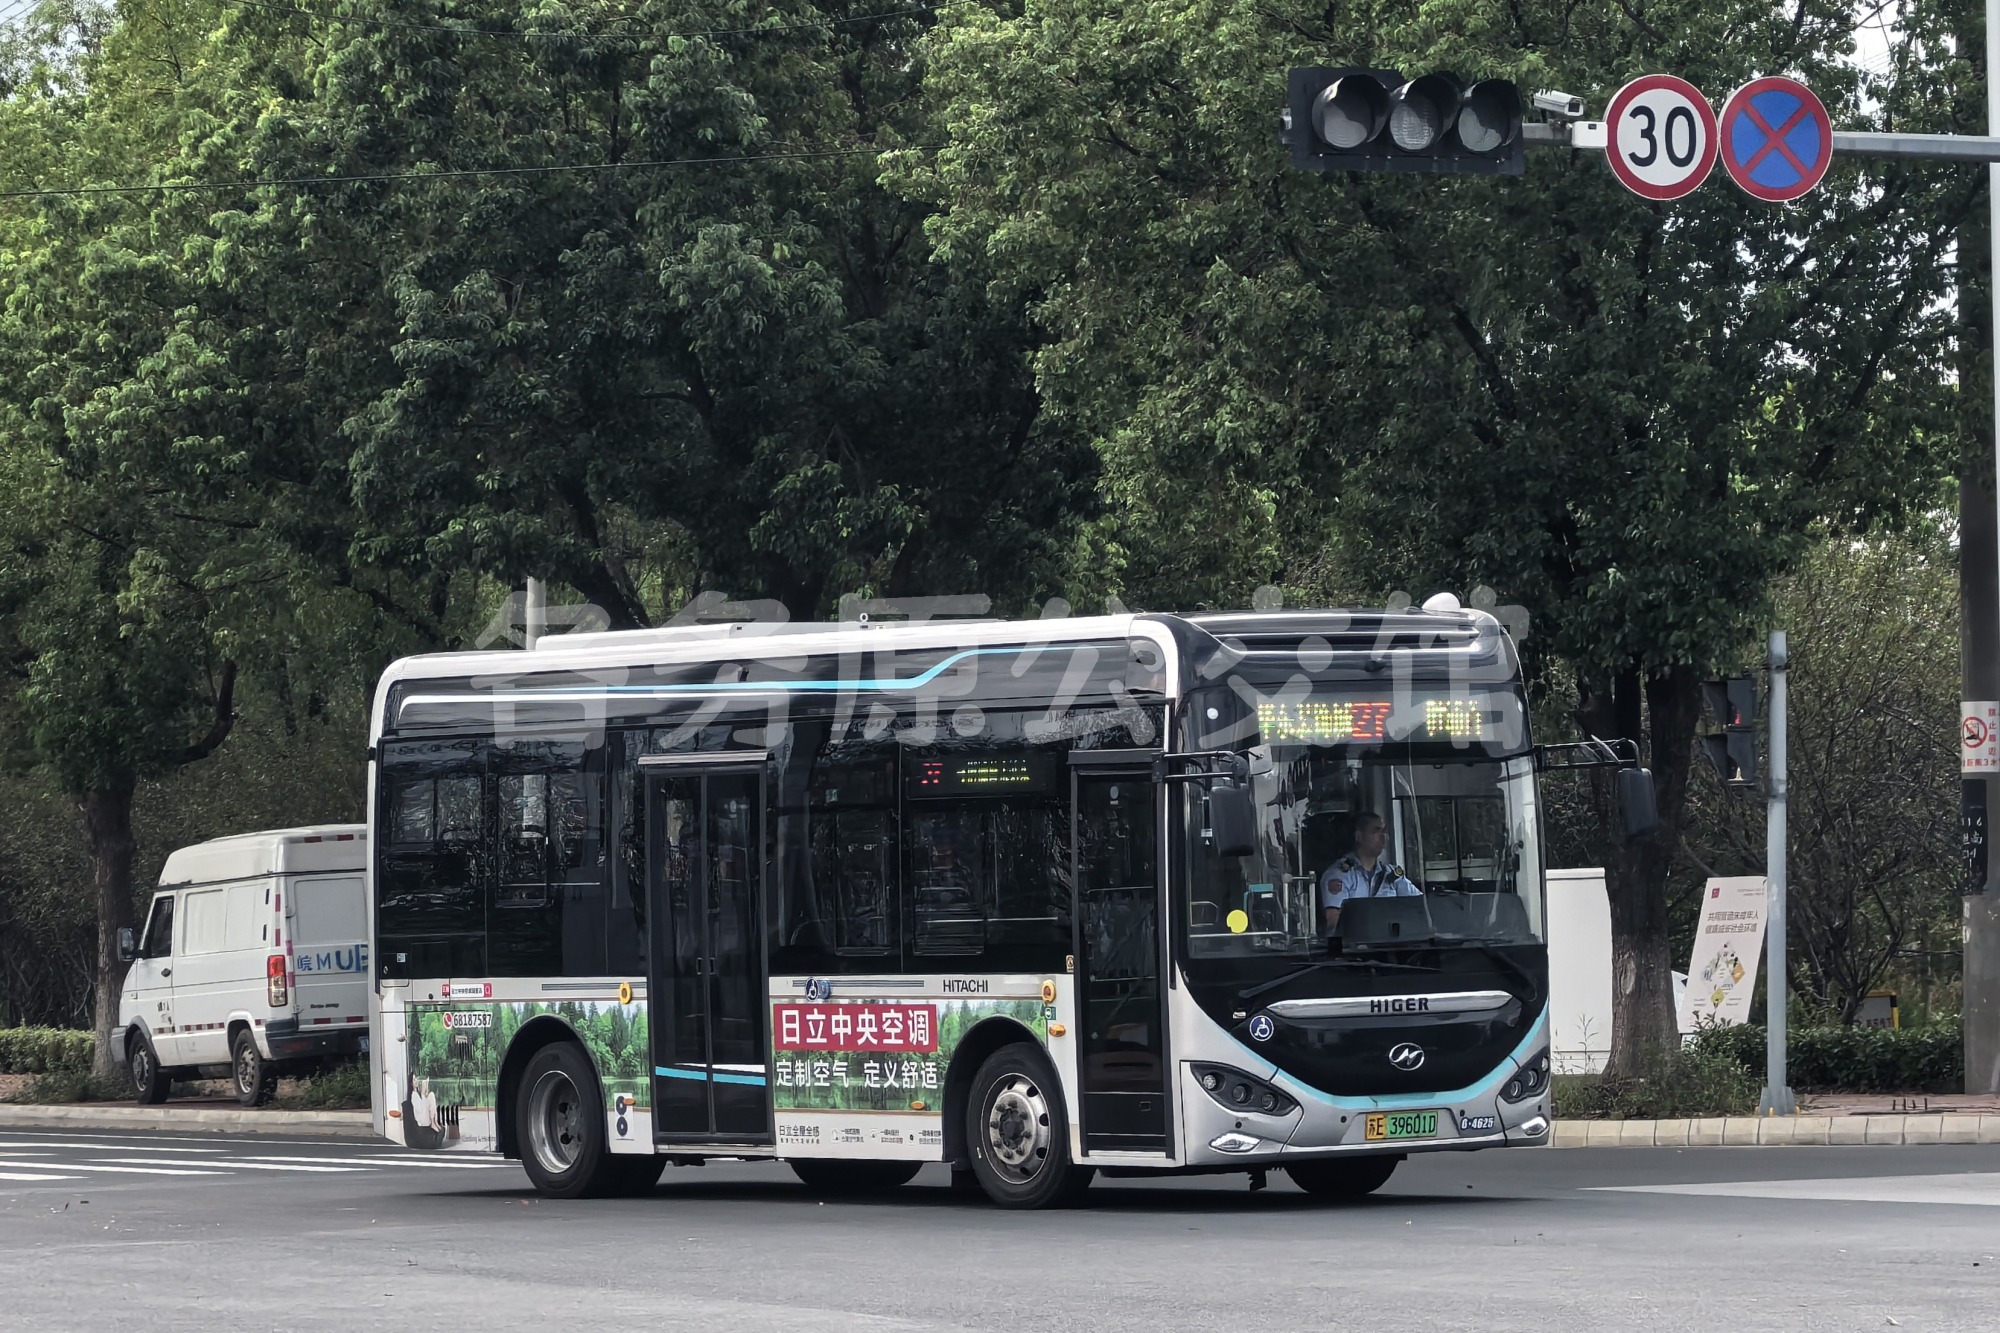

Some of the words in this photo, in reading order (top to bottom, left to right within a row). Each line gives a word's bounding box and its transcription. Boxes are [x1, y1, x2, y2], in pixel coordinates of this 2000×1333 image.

[1627, 104, 1697, 168] 30
[1352, 702, 1391, 738] 27
[942, 979, 988, 993] HITACHI
[453, 1012, 492, 1028] 68187587
[1369, 997, 1430, 1013] HIGER
[781, 1008, 930, 1046] 日立中央空调
[776, 1060, 849, 1088] 定制空气
[863, 1060, 938, 1090] 定义舒适
